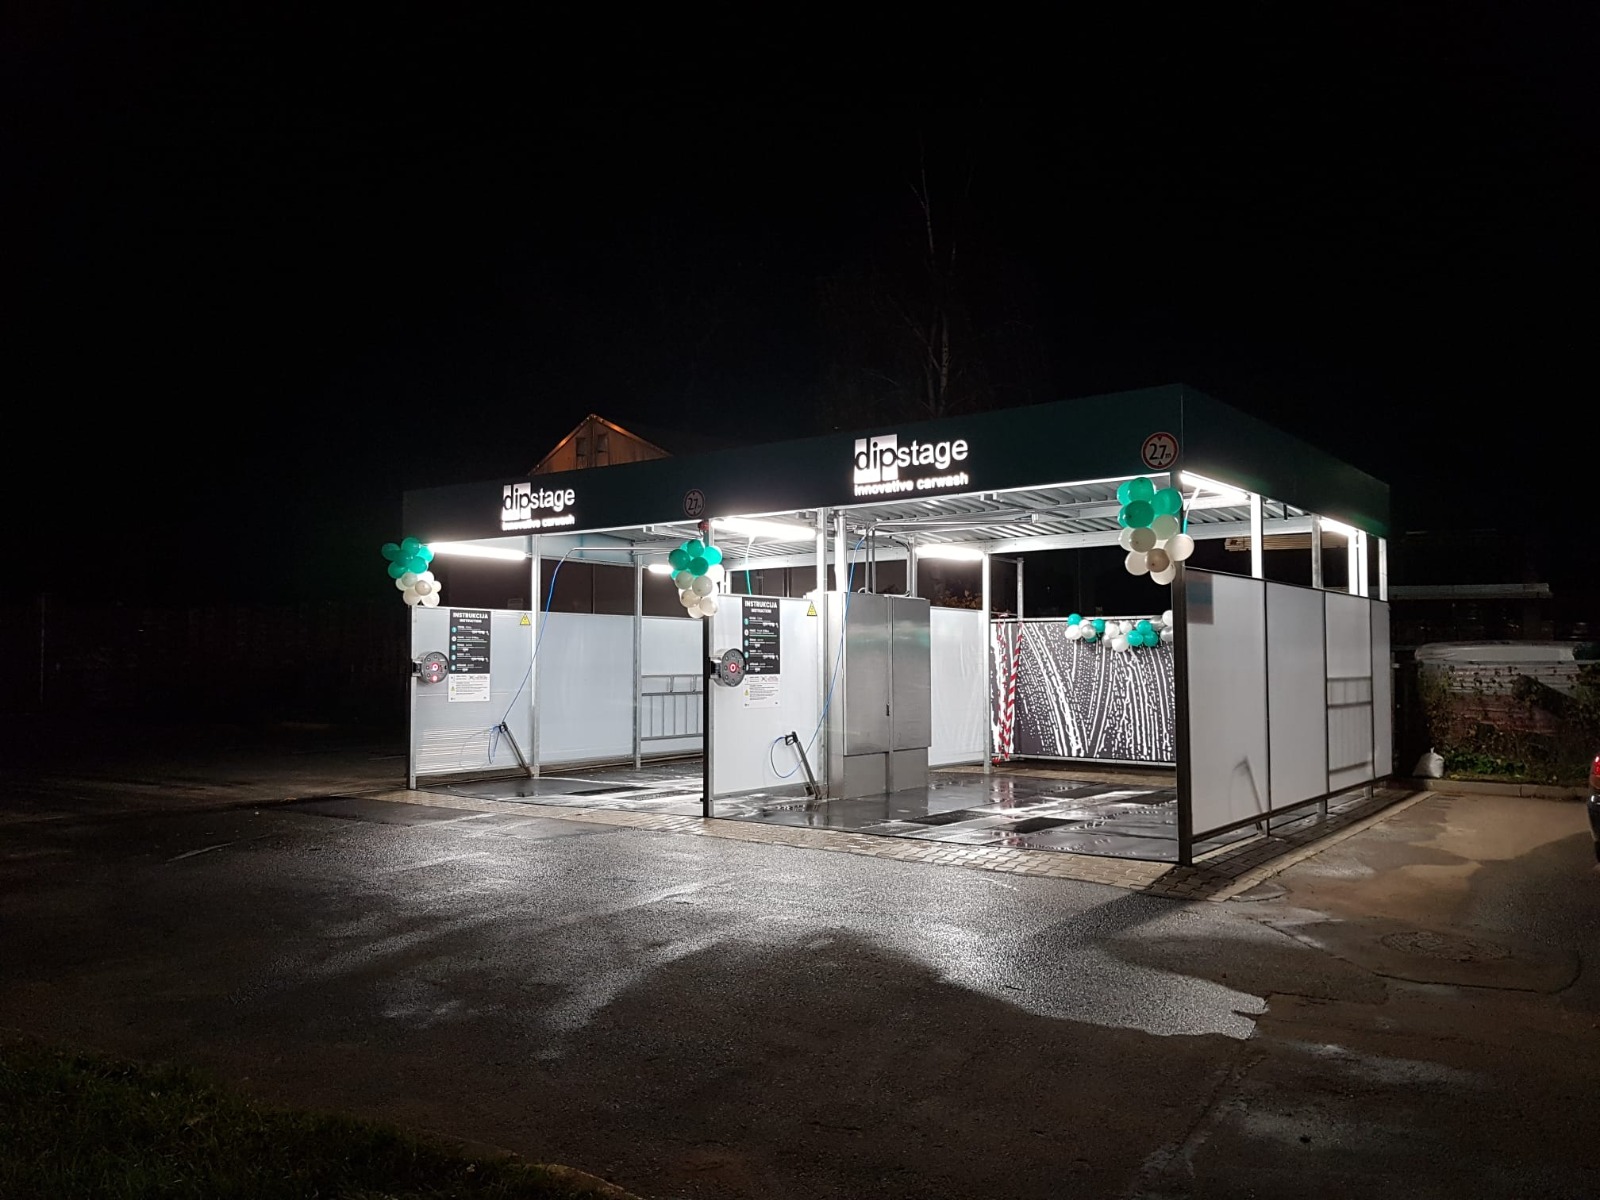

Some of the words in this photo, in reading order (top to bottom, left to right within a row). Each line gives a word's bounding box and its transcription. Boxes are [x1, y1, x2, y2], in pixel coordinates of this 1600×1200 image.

[854, 434, 968, 482] dipstage
[502, 483, 575, 520] dipstage
[854, 480, 914, 496] innovative
[916, 472, 969, 490] carwash
